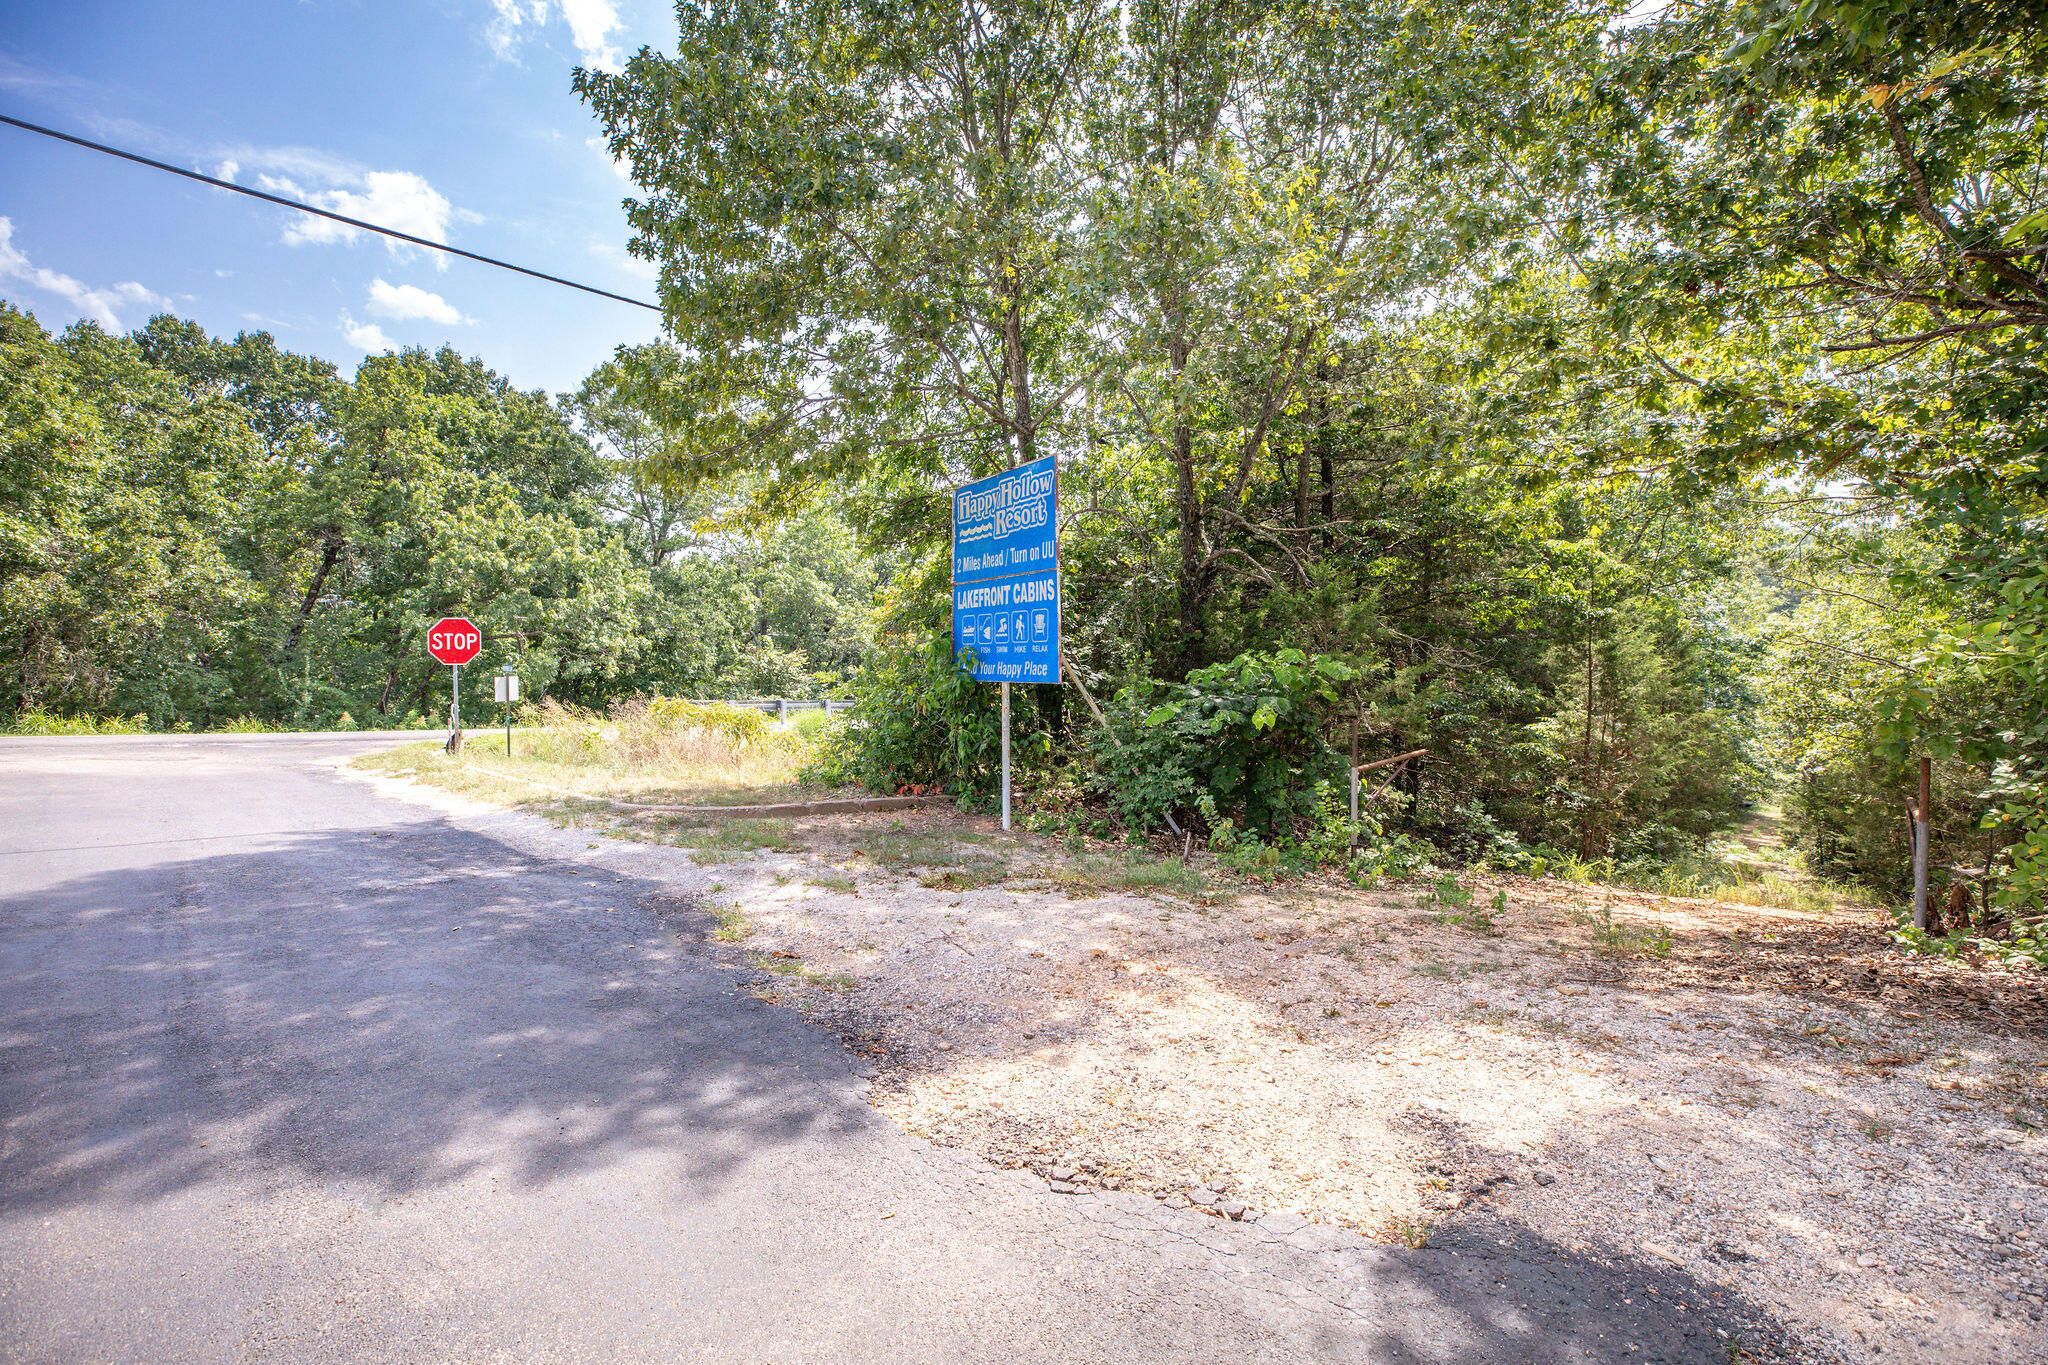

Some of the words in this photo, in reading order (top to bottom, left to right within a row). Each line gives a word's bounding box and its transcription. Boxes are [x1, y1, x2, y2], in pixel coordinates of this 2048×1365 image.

[959, 492, 1000, 520] Happy
[1000, 474, 1052, 508] Hollow
[995, 500, 1044, 535] Resort
[957, 558, 962, 573] 2
[963, 556, 981, 572] Miles
[982, 549, 1004, 569] Ahead
[1005, 548, 1009, 567] /
[1010, 547, 1028, 564] Turn
[1029, 547, 1040, 561] on
[1042, 540, 1054, 559] UU
[957, 585, 1010, 610] LAKEFRONT
[1013, 578, 1055, 604] CABINS
[431, 633, 478, 650] STOP
[980, 646, 991, 654] FISH
[1014, 645, 1027, 653] HIKE
[1032, 645, 1048, 653] RELAX
[980, 661, 996, 675] Your
[996, 661, 1022, 679] Happy
[1024, 661, 1047, 676] Place
